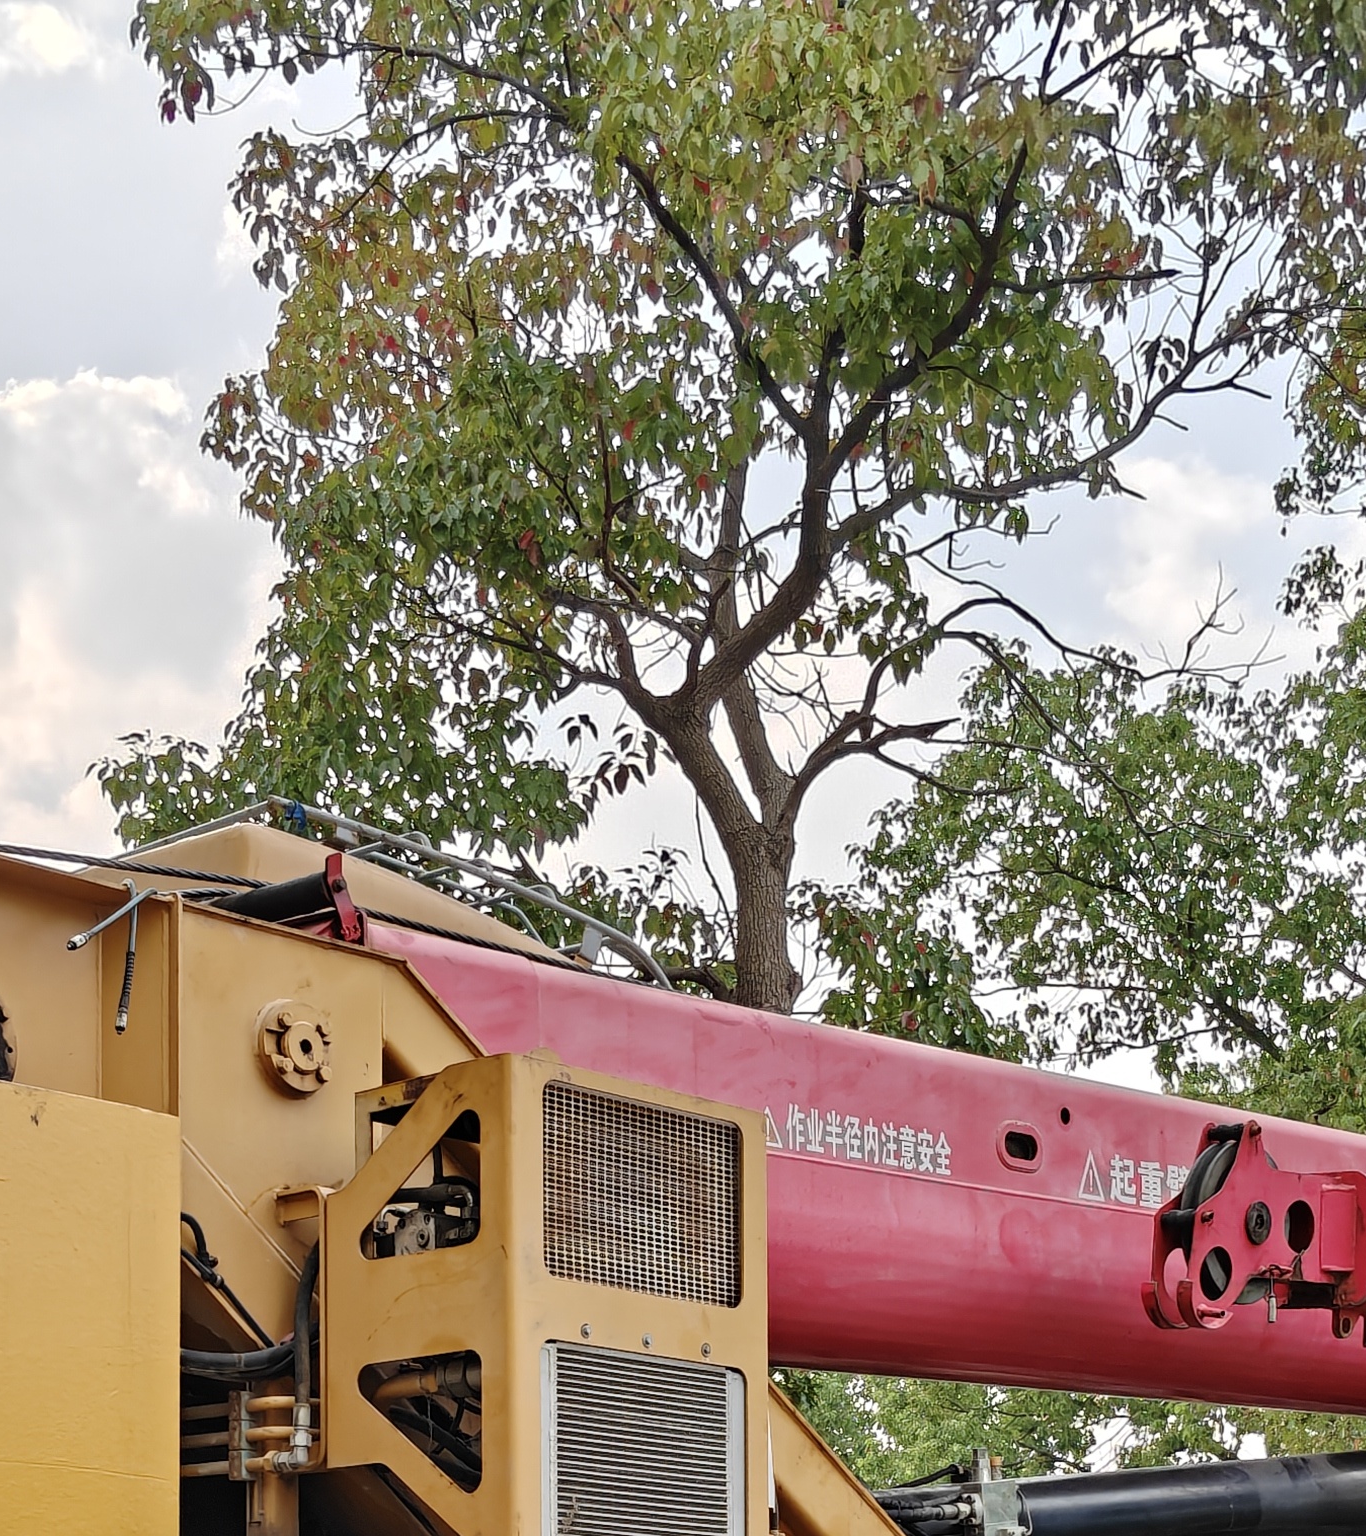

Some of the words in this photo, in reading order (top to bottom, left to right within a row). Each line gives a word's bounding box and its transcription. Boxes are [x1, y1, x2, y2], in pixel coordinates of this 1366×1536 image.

[786, 1102, 952, 1176] 作业半径内注意安全
